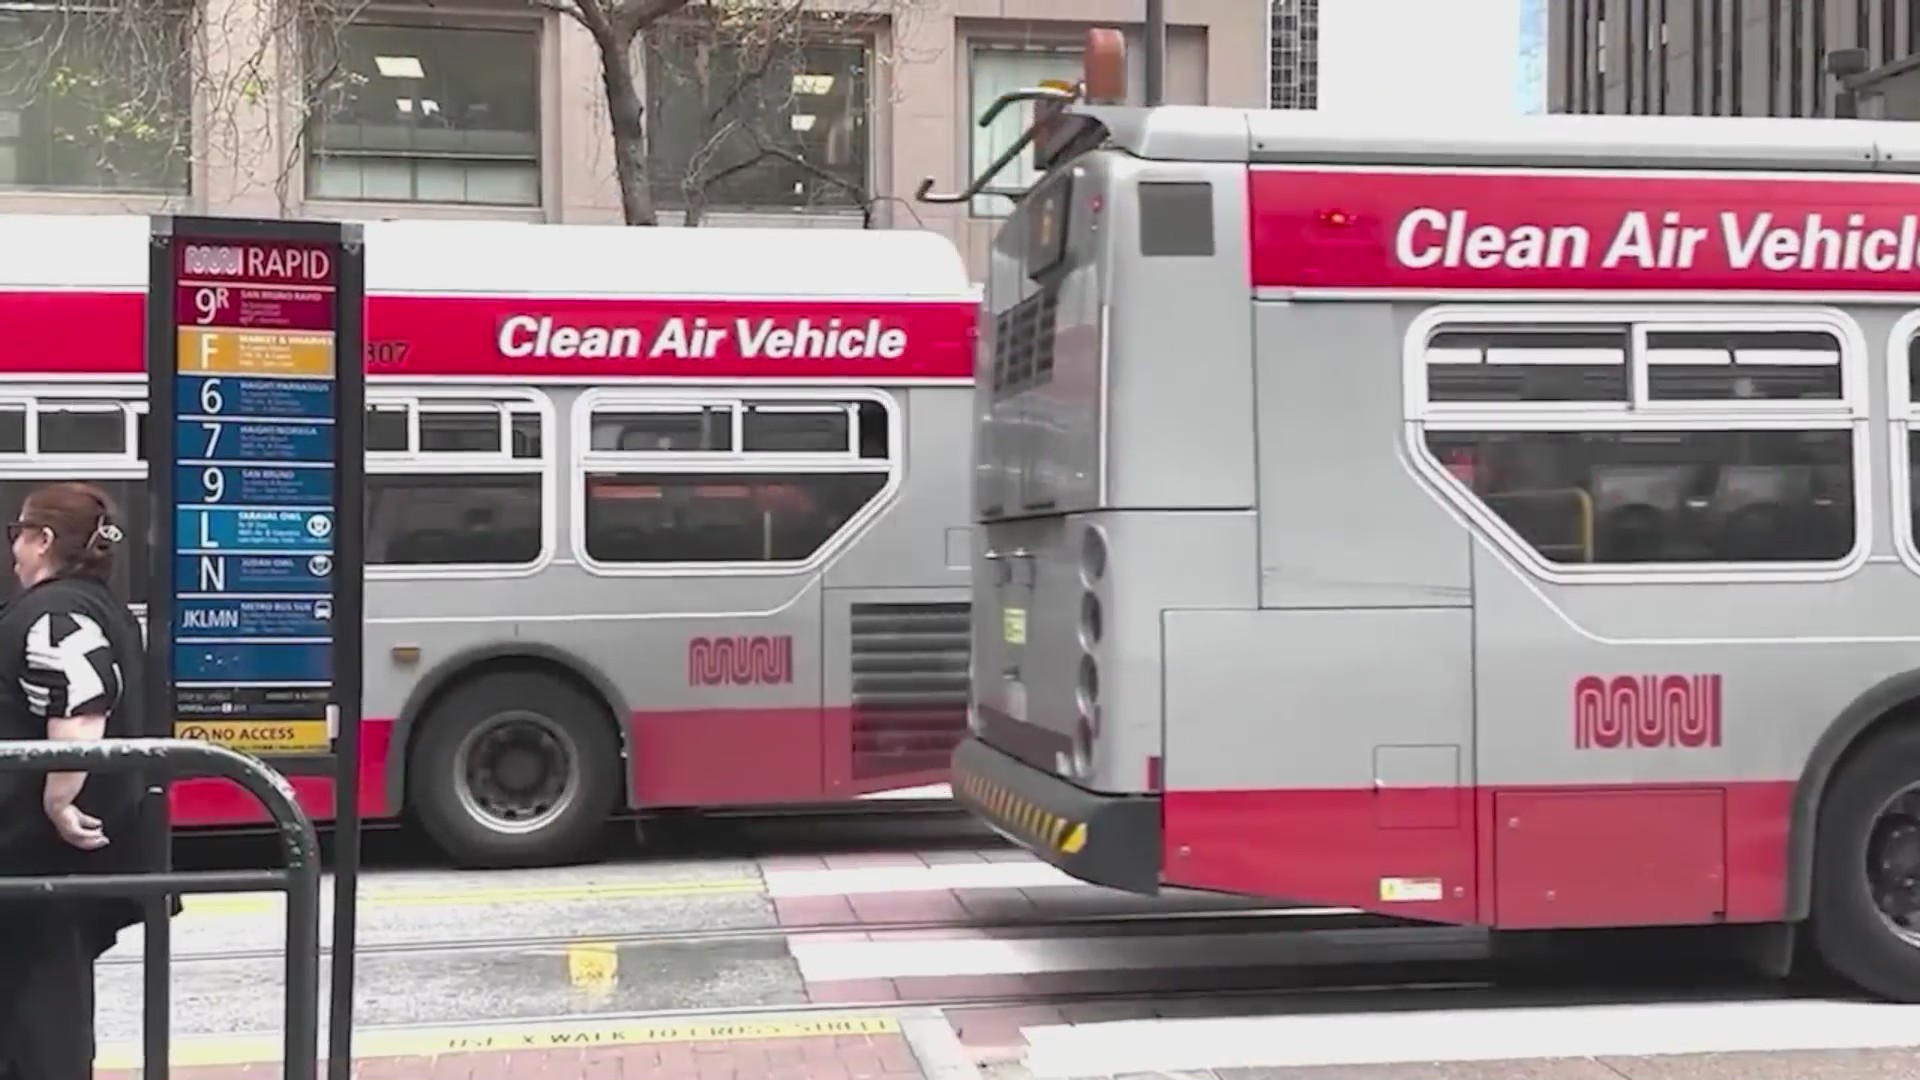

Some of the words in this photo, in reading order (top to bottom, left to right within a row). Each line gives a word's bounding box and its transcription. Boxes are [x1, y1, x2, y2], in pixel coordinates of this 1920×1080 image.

[1396, 208, 1590, 269] Clean
[1602, 210, 1707, 269] Air
[1719, 211, 1920, 272] Vehicl
[248, 247, 330, 280] RAPID
[201, 333, 219, 369] F
[498, 314, 640, 359] Clean
[649, 316, 726, 359] Air
[735, 317, 907, 360] Vehicle
[201, 378, 223, 414] 6
[202, 423, 222, 458] 7
[203, 467, 225, 503] 9
[201, 511, 219, 548] L
[201, 556, 225, 591] N
[182, 608, 239, 628] JKLMN
[212, 727, 235, 740] NO
[239, 727, 294, 741] ACCESS
